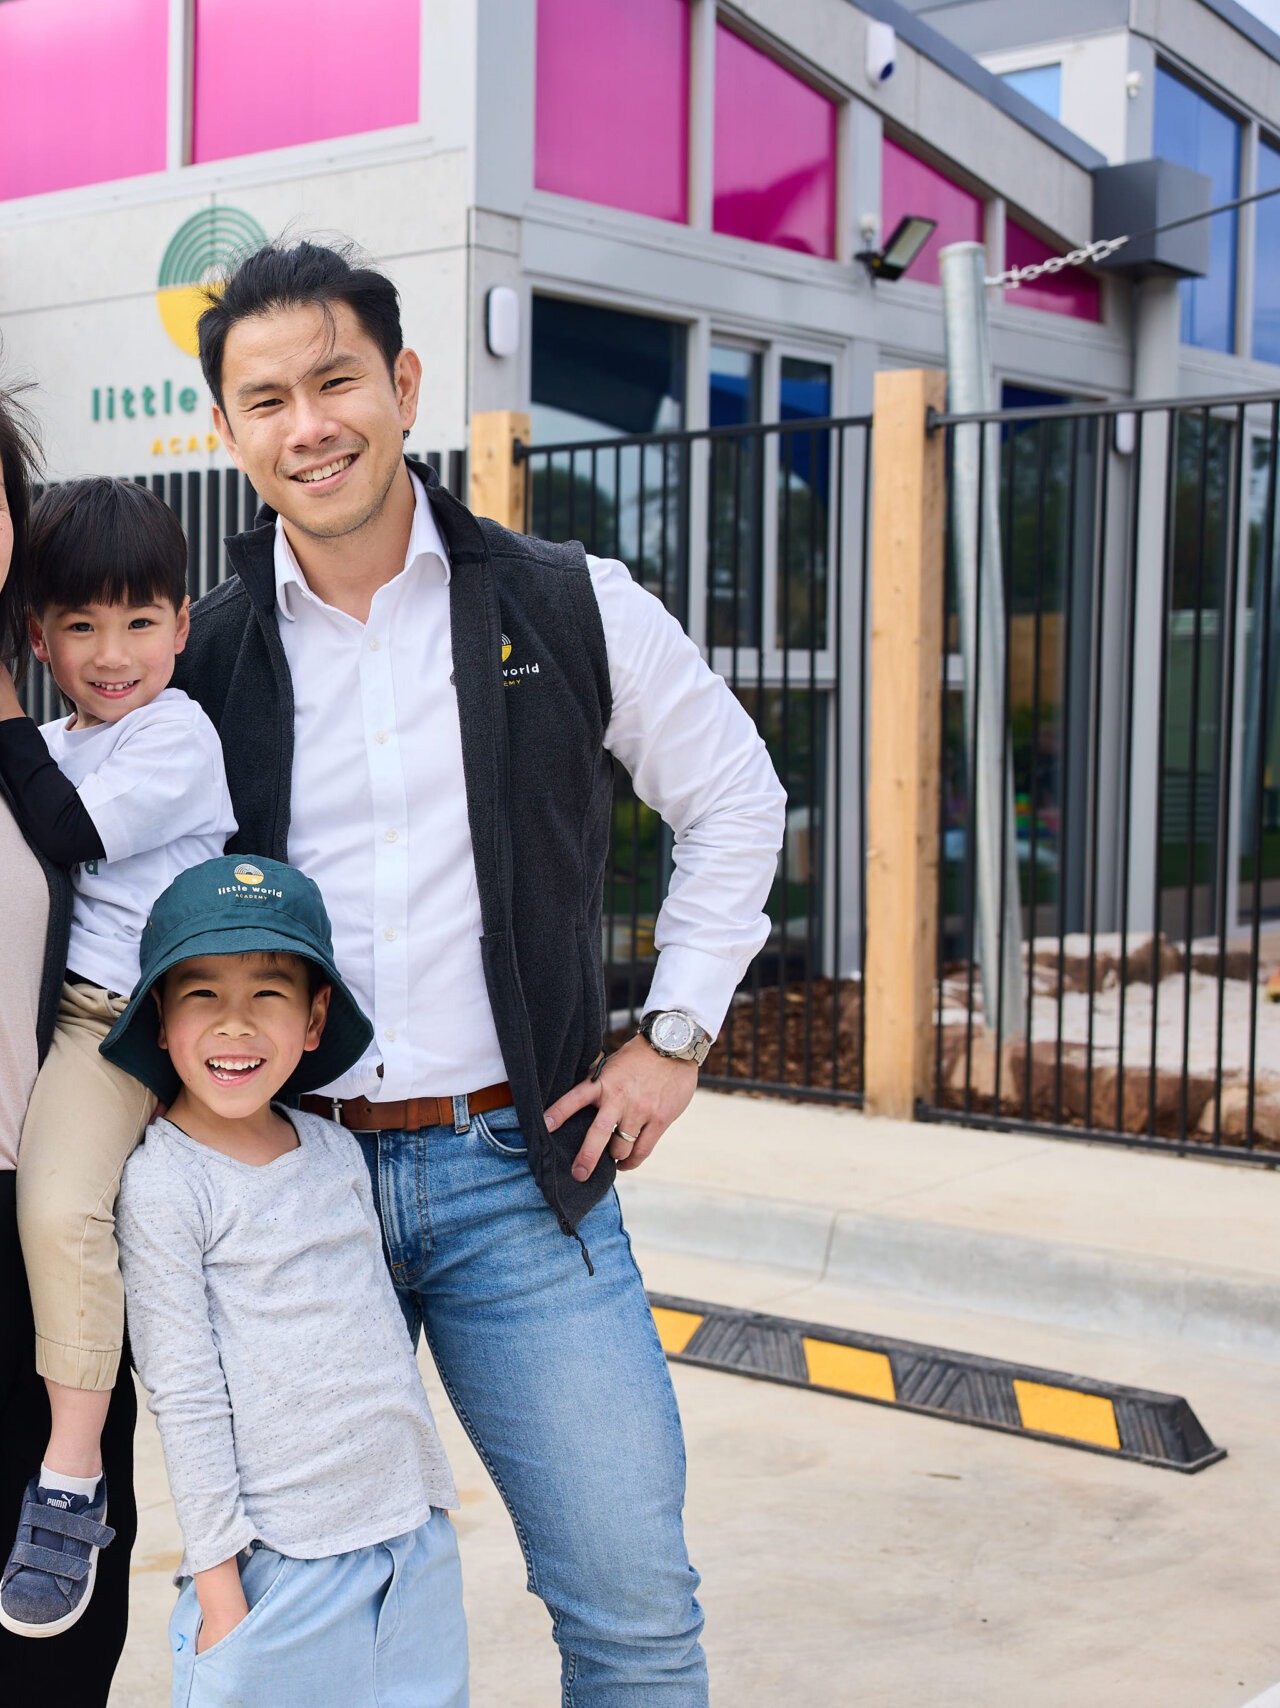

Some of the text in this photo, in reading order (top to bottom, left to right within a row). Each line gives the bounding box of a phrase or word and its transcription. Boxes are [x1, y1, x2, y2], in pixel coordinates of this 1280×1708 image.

[92, 379, 198, 422] little
[218, 884, 283, 898] little world
[46, 1497, 68, 1510] PUMA
